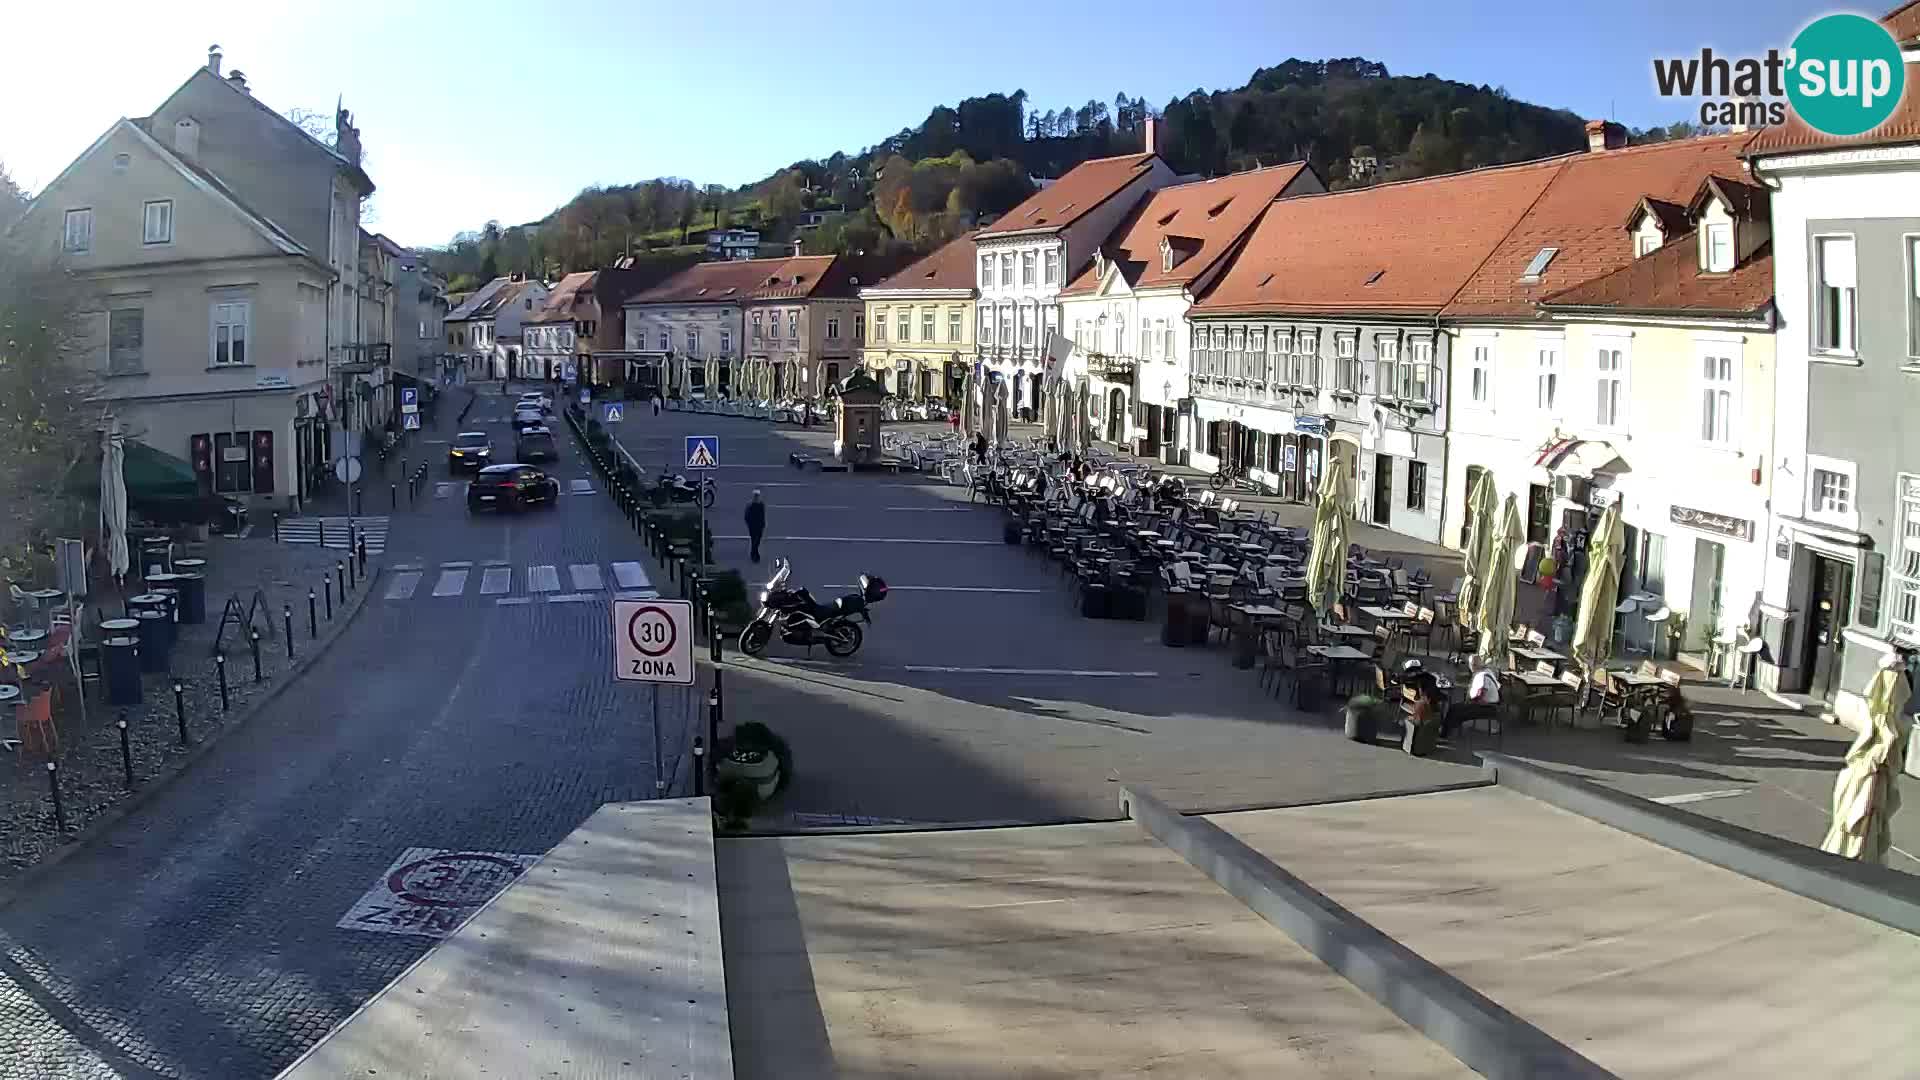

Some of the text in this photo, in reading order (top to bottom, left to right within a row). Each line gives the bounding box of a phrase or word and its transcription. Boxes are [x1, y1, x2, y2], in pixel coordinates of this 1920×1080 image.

[405, 391, 414, 403] P
[641, 622, 665, 643] 30
[631, 659, 676, 677] ZONA
